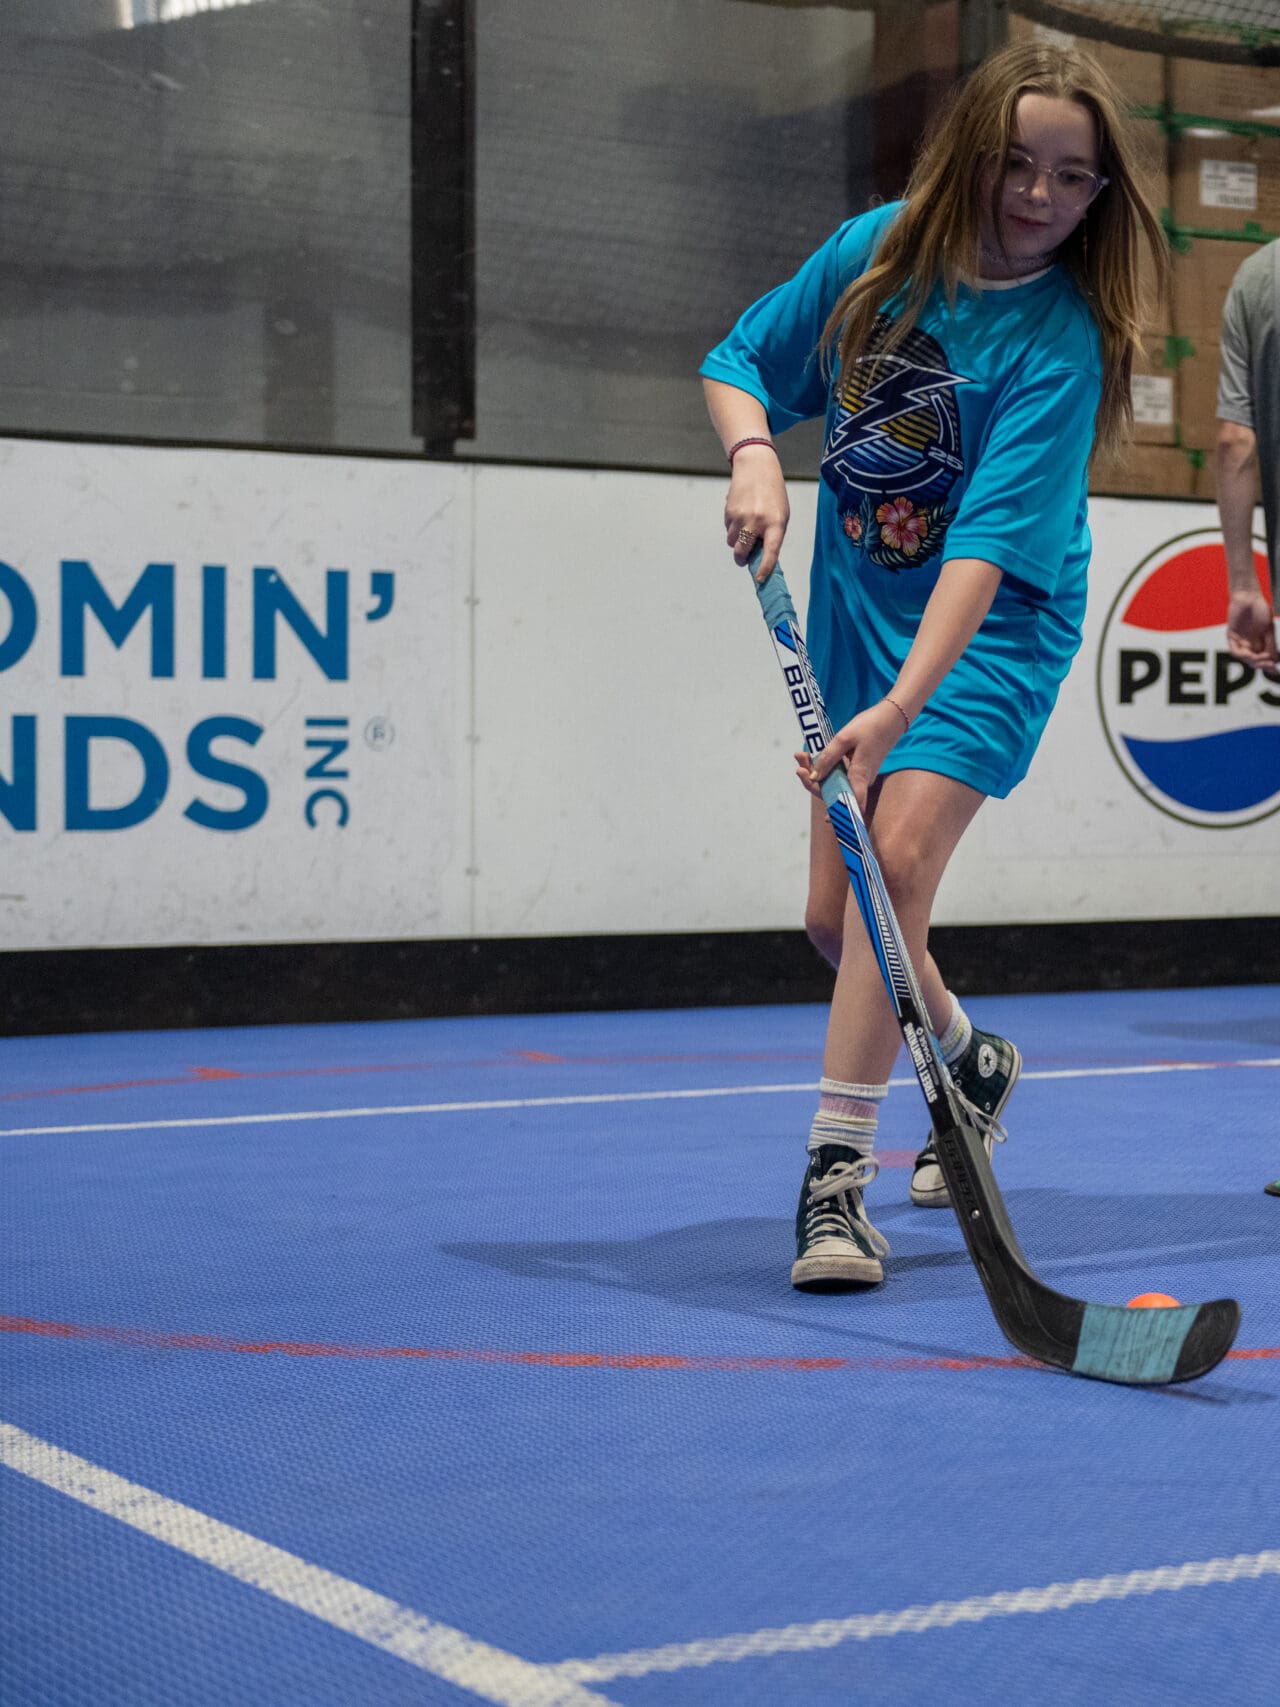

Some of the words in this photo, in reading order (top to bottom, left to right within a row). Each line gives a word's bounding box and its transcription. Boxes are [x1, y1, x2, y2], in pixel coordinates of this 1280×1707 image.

[784, 664, 826, 754] Baue
[304, 716, 350, 830] INC
[903, 1021, 927, 1070] LIGHTNING
[919, 1067, 938, 1104] STREET
